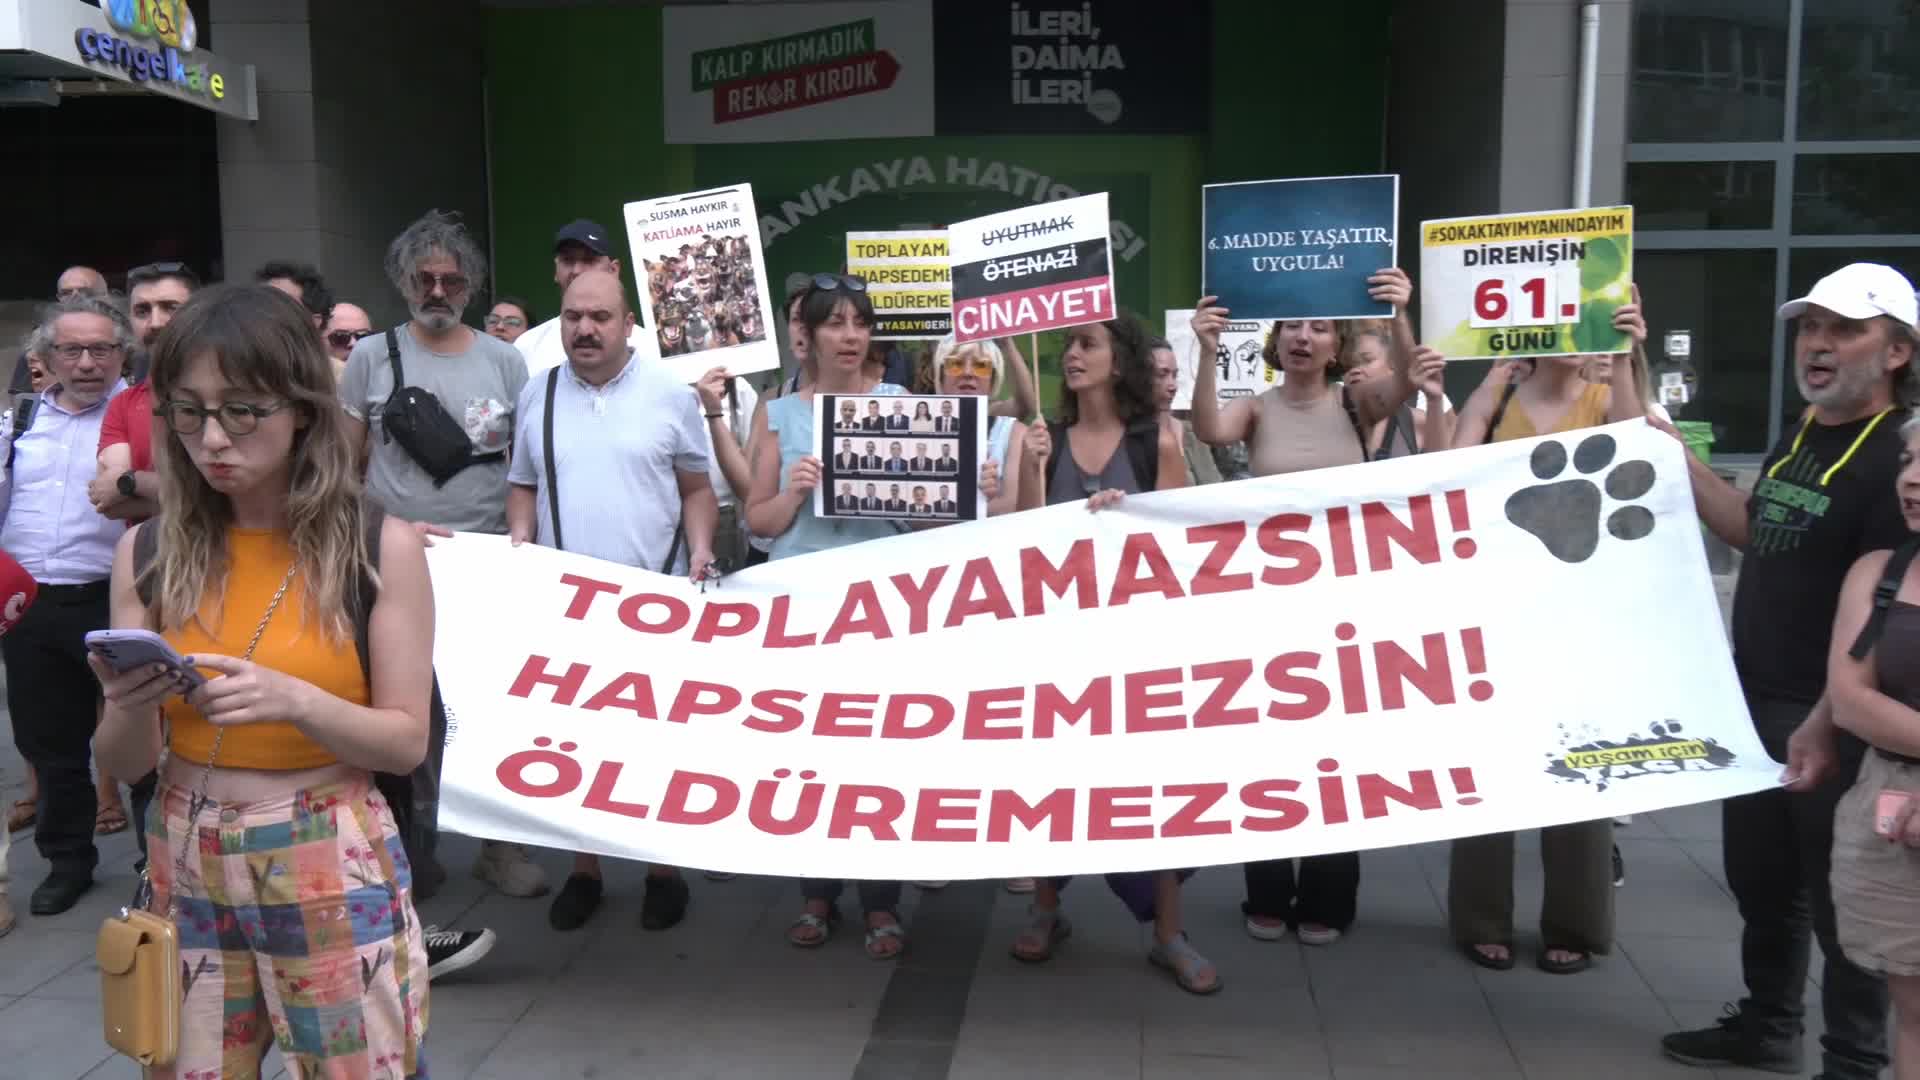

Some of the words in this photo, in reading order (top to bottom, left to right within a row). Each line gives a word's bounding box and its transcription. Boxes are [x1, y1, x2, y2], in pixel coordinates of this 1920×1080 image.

[1010, 1, 1101, 40] İLERİ,
[700, 50, 753, 83] KALP
[762, 25, 865, 71] KIRMADIK
[1011, 36, 1126, 70] DAİMA
[806, 59, 878, 99] KIRDIK
[650, 207, 688, 222] SUSMA
[690, 201, 728, 214] HAYKIR
[760, 156, 936, 249] ANKAYA
[643, 224, 704, 242] KATLİAMA
[706, 217, 741, 232] HAYIR
[982, 215, 1074, 245] UYUTMAK
[1223, 231, 1296, 249] MADDE
[1300, 227, 1393, 249] YAŞATIR,
[1429, 214, 1625, 242] #SOKAKTAYIMYANINDAYIM
[856, 243, 950, 258] TOPLAYAM
[983, 244, 1078, 282] ÖTENAZİ
[1252, 255, 1344, 272] UYGULA!
[1463, 238, 1585, 267] DİRENİŞİN
[871, 291, 950, 309] LDÜREME
[957, 283, 1108, 335] CİNAYET
[876, 318, 953, 331] #YASAYIGERİ
[1489, 328, 1557, 351] GÜNÜ
[560, 489, 1477, 648] TOPLAYAMAZSIN!
[507, 622, 1494, 740] HAPSEDEMEZSİN!
[495, 757, 1485, 843] ÖLDÜREMEZSİN!
